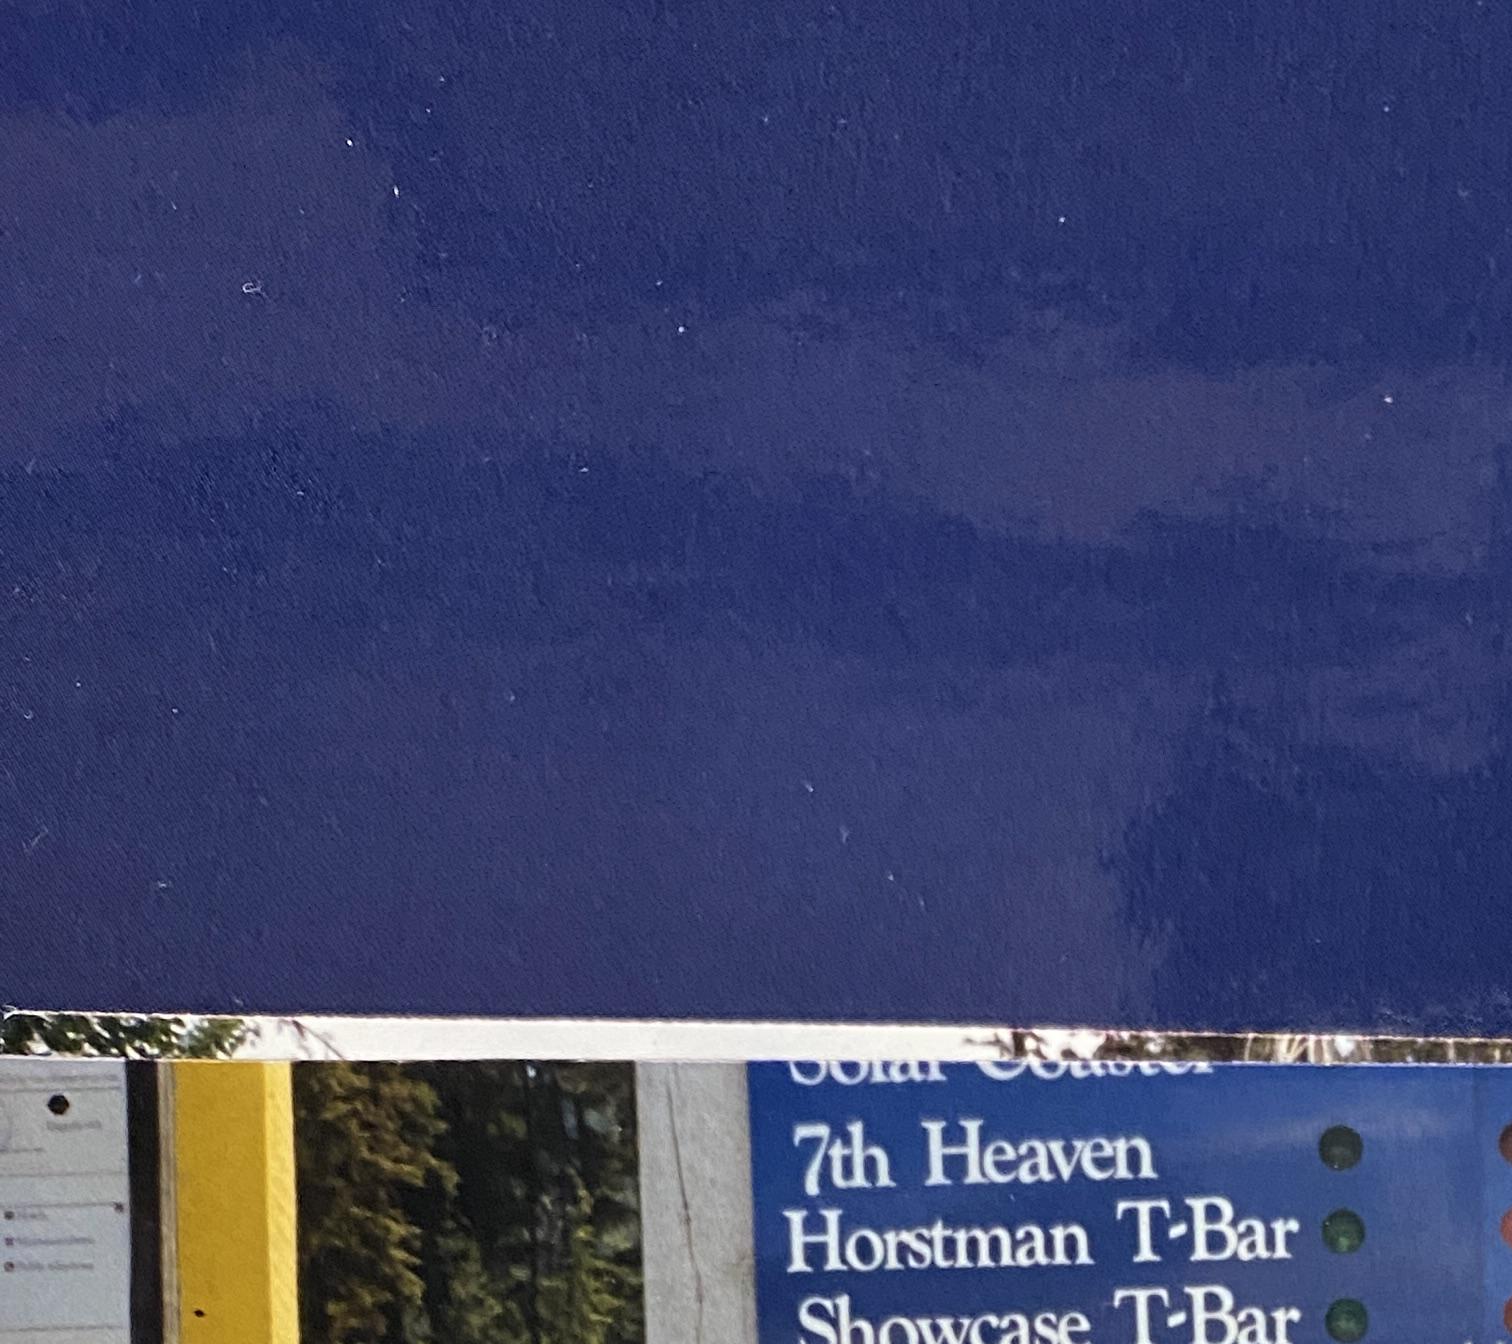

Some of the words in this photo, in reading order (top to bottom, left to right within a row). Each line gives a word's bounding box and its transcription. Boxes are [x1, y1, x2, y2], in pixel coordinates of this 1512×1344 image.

[792, 1123, 894, 1196] 7th
[923, 1120, 1158, 1187] Heaven
[785, 1209, 1094, 1272] Horstman
[1117, 1197, 1300, 1263] T-Bar
